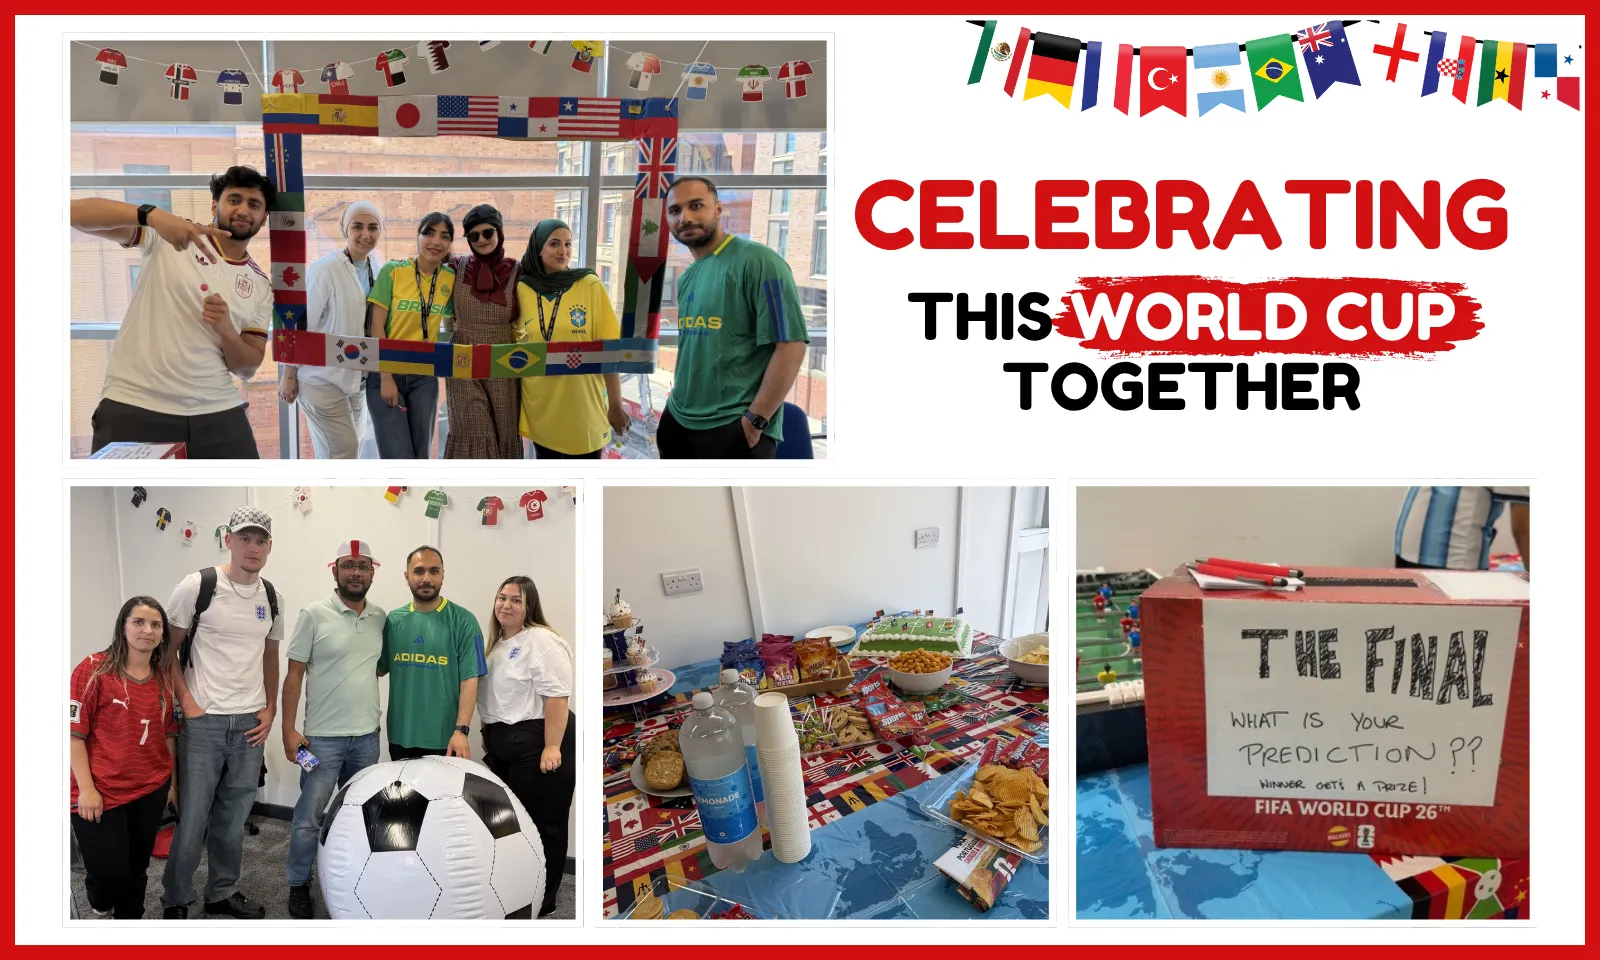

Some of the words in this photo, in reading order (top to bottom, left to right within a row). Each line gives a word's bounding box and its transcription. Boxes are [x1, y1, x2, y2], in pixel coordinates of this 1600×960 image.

[394, 653, 448, 666] ADIDAS
[1240, 627, 1342, 680] THE
[1364, 625, 1494, 708] FINAL
[1230, 711, 1289, 730] WHAT
[1302, 711, 1324, 730] IS
[1350, 712, 1405, 733] YOUR
[139, 719, 150, 746] 7
[1238, 742, 1436, 768] PREDICTION
[1259, 779, 1306, 790] WINNER
[1357, 780, 1366, 792] A
[695, 791, 741, 805] LEMONADE
[1255, 800, 1293, 815] FIFA
[1298, 800, 1369, 817] WORLD
[1373, 803, 1412, 819] CUP
